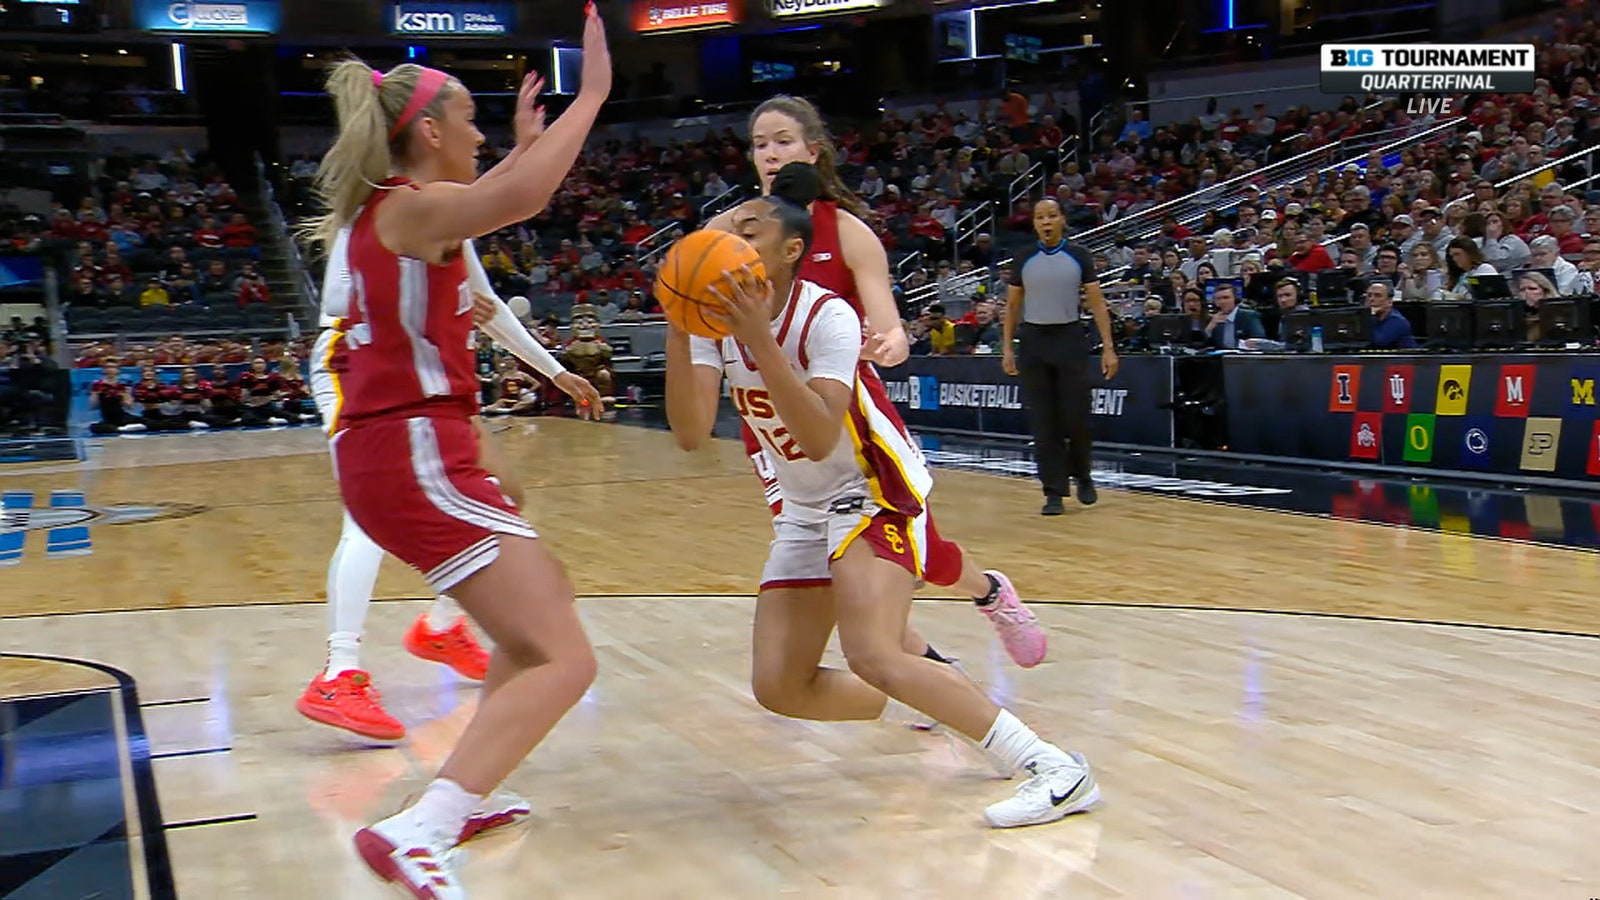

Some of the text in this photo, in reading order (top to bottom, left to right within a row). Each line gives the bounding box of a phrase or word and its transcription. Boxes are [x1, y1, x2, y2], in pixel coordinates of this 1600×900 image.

[395, 5, 455, 31] ksm
[730, 386, 776, 419] US
[940, 383, 1022, 409] BASKETBALL
[1505, 376, 1523, 403] M
[1571, 378, 1595, 405] M
[758, 427, 807, 461] 12
